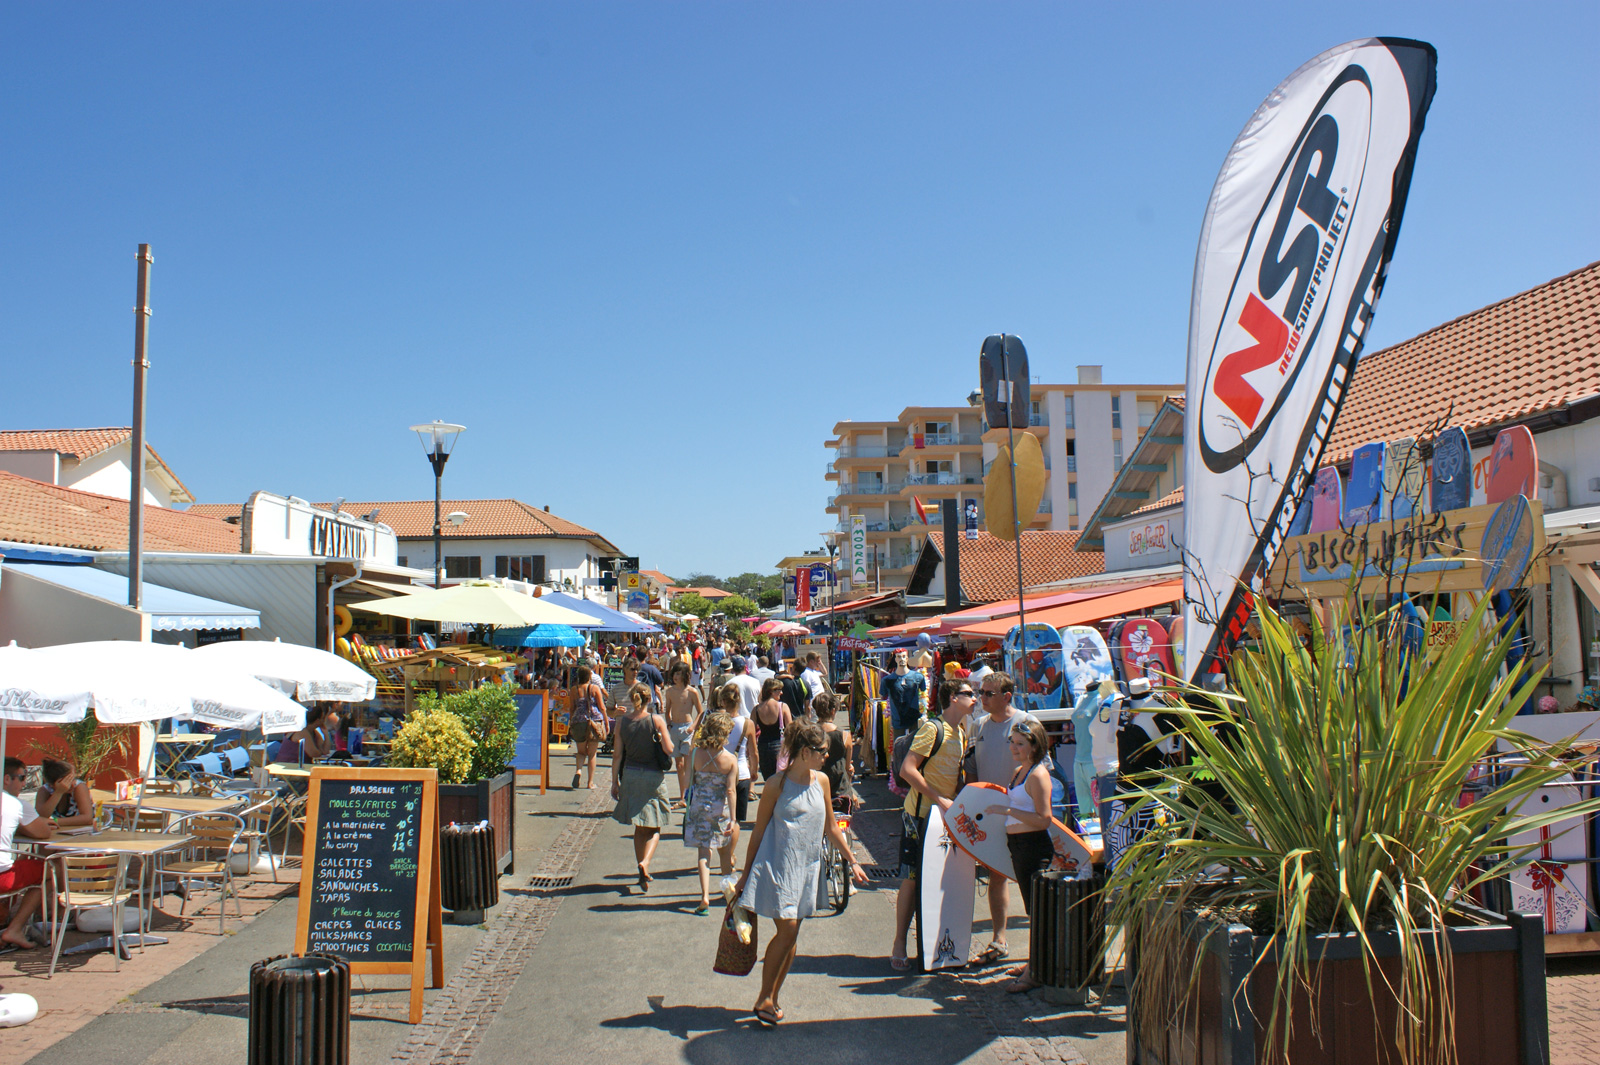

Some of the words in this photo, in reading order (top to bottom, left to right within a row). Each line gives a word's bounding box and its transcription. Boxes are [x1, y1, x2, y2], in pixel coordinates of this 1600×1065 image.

[1213, 113, 1339, 431] NSP
[853, 529, 866, 576] MOOREA
[203, 700, 247, 720] Pilsener
[341, 810, 350, 818] de
[356, 810, 391, 818] Bouchot
[333, 821, 340, 829] la
[333, 832, 341, 840] la
[325, 841, 335, 849] Au
[335, 843, 359, 853] curry
[320, 858, 373, 868] GALETTES
[319, 868, 363, 879] SALADES
[320, 893, 351, 904] TAPAS
[364, 908, 373, 917] du
[375, 909, 401, 919] sucré
[364, 919, 402, 930] GLACES
[310, 931, 373, 941] MILKSHAKES
[312, 941, 370, 953] SMOOTHIES
[376, 941, 413, 953] COCKTAILS
